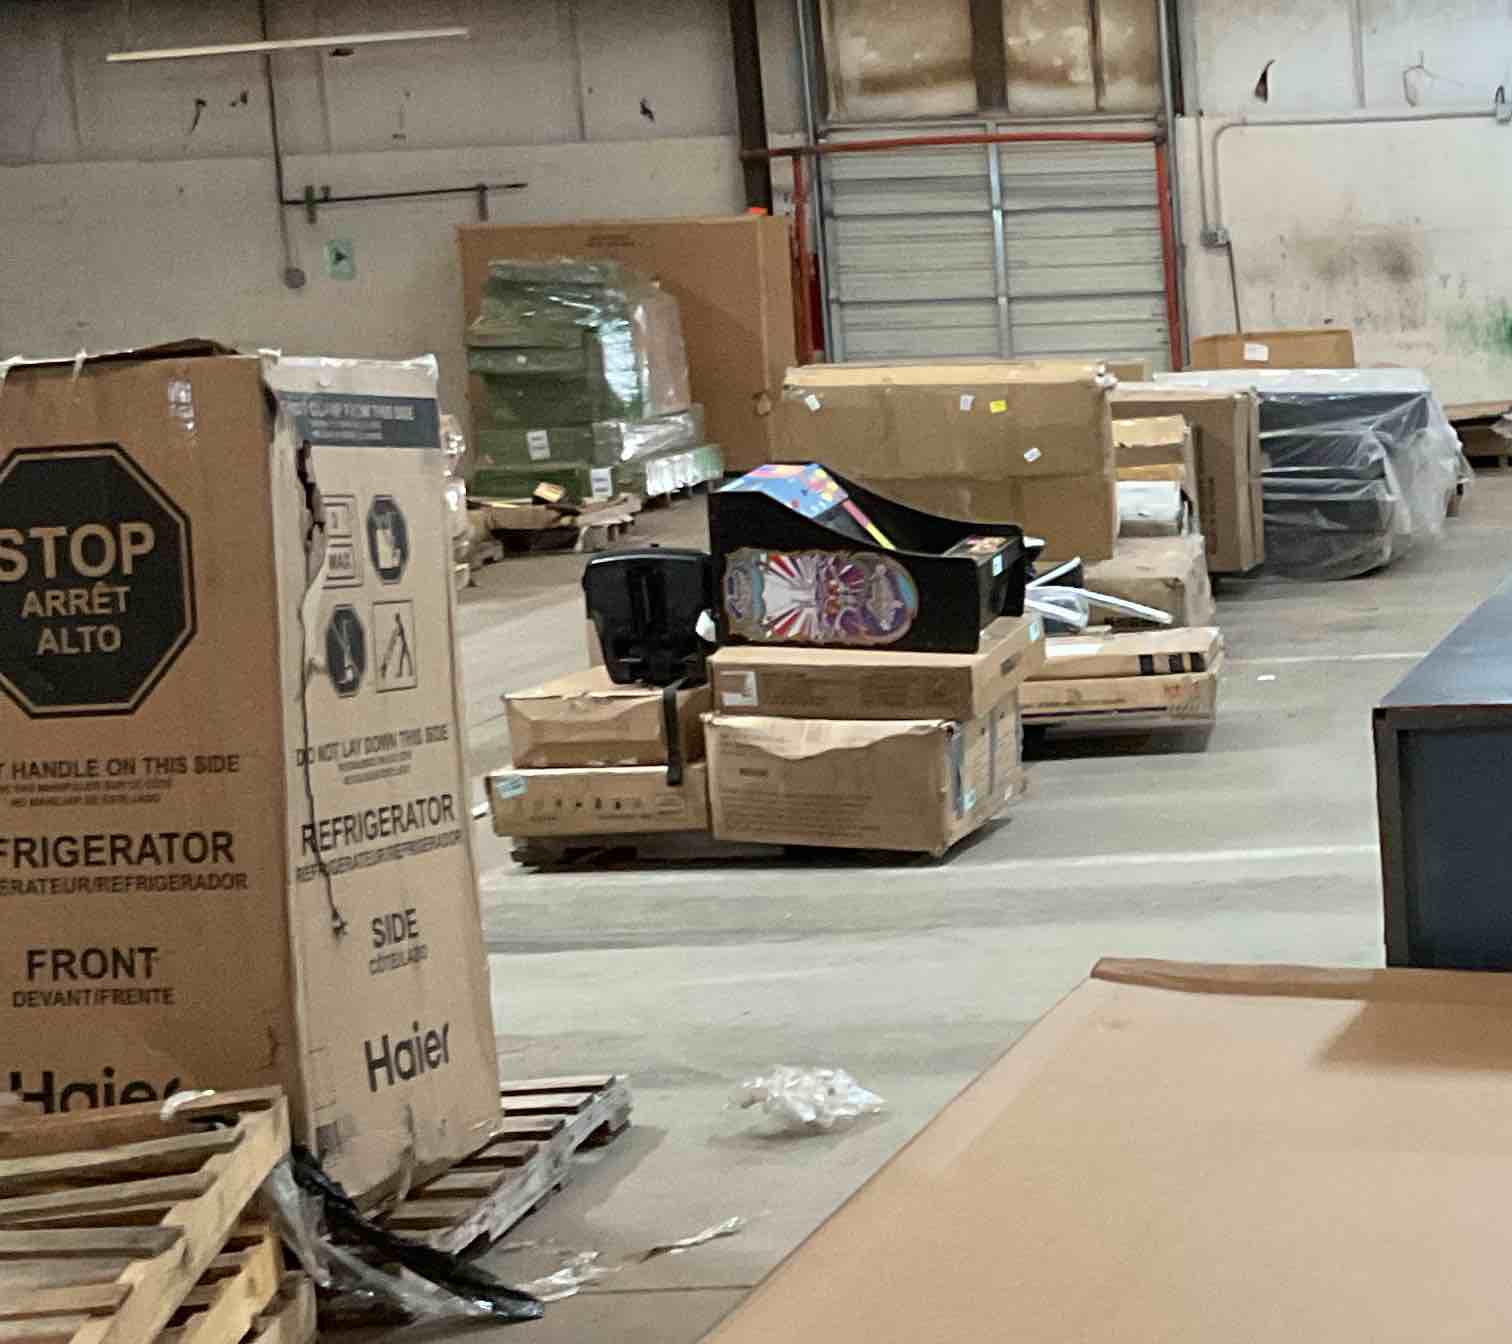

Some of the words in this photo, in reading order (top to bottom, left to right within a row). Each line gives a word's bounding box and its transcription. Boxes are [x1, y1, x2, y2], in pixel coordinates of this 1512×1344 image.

[0, 522, 156, 583] STOP
[22, 580, 132, 619] ARRÊT
[37, 624, 122, 655] ALTO
[12, 759, 101, 779] HANDLE
[105, 758, 136, 776] ON
[142, 756, 188, 775] THIS
[193, 754, 241, 774] SIDE
[301, 793, 456, 856] REFRIGERATOR
[371, 907, 420, 949] SIDE
[26, 946, 159, 982] FRONT
[363, 1020, 450, 1093] Haier
